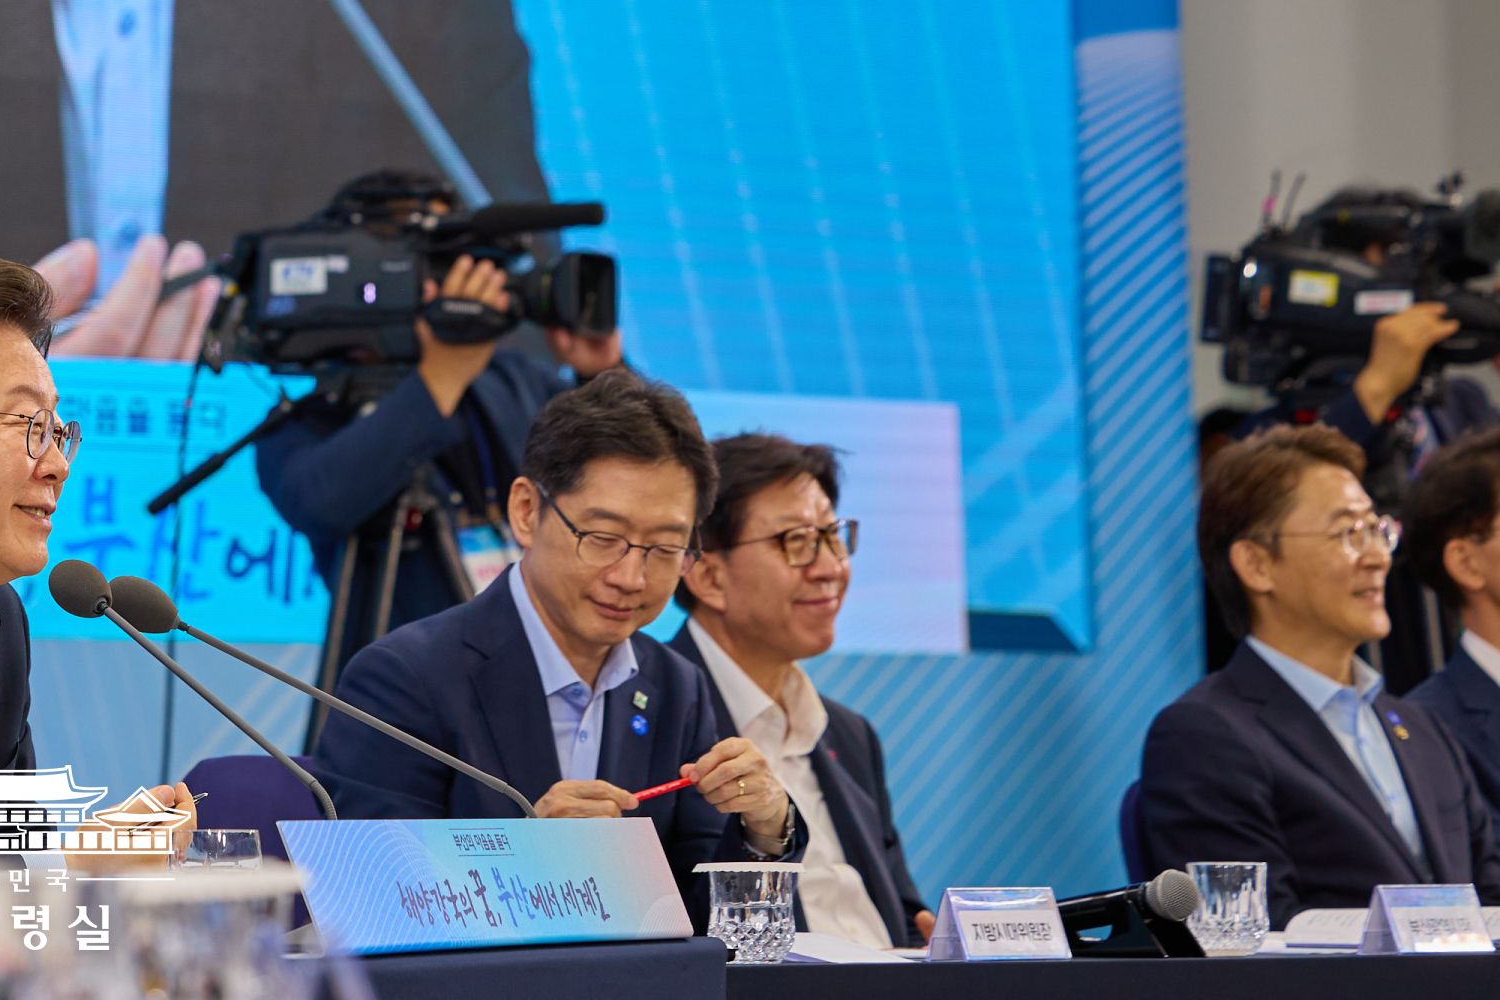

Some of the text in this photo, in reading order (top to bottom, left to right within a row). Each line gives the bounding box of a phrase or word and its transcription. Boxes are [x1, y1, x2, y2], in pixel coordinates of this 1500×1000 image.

[63, 476, 316, 606] 부산에
[452, 833, 477, 852] 부산의
[473, 833, 498, 851] 마음을
[397, 879, 478, 928] 해양강국의
[491, 866, 564, 928] 부산에서
